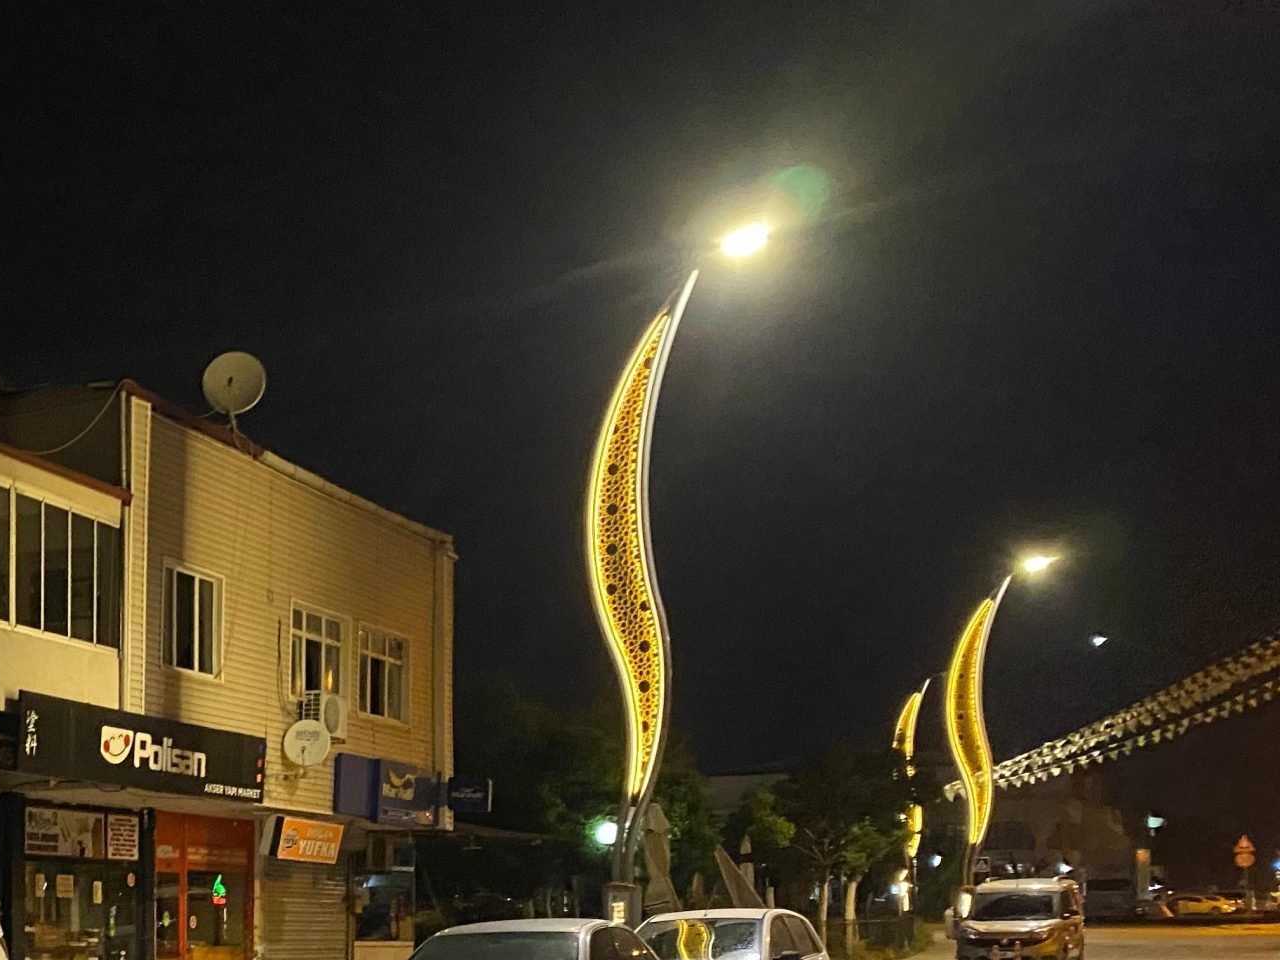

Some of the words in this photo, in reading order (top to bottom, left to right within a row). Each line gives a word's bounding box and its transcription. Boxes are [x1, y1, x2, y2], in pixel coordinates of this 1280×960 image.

[133, 731, 207, 778] Polisan
[238, 788, 261, 800] MARKET
[298, 840, 336, 857] YUFKA
